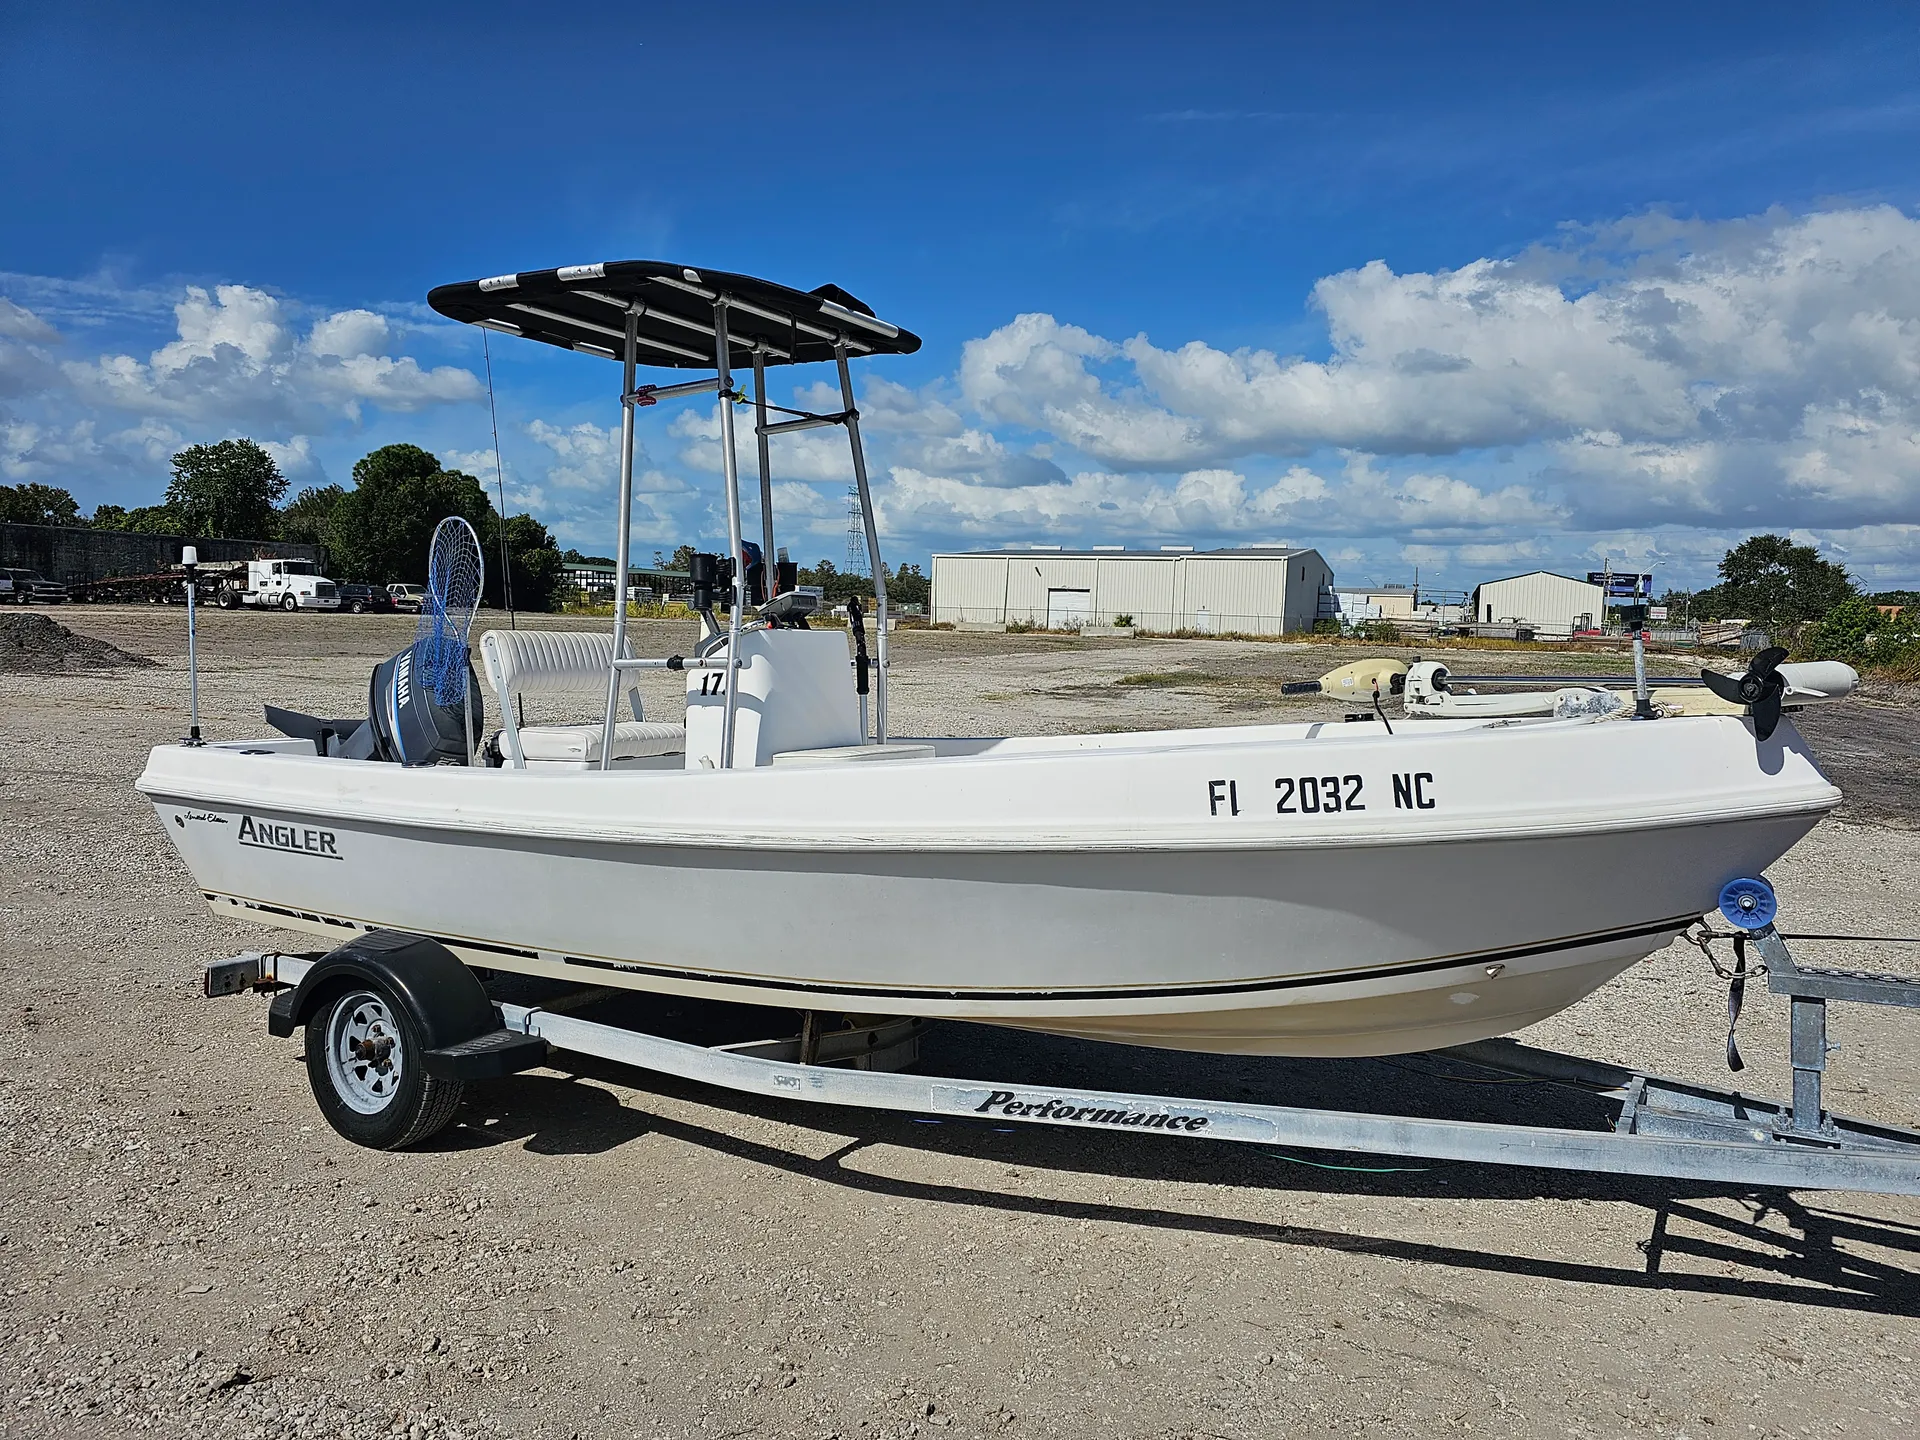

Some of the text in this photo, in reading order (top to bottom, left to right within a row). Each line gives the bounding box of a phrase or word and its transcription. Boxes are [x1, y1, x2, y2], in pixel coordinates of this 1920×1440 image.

[397, 650, 413, 709] YAMAHA
[700, 672, 726, 696] 17
[1275, 774, 1366, 814] 2032
[1392, 772, 1436, 810] NC
[974, 1090, 1209, 1131] Performance
